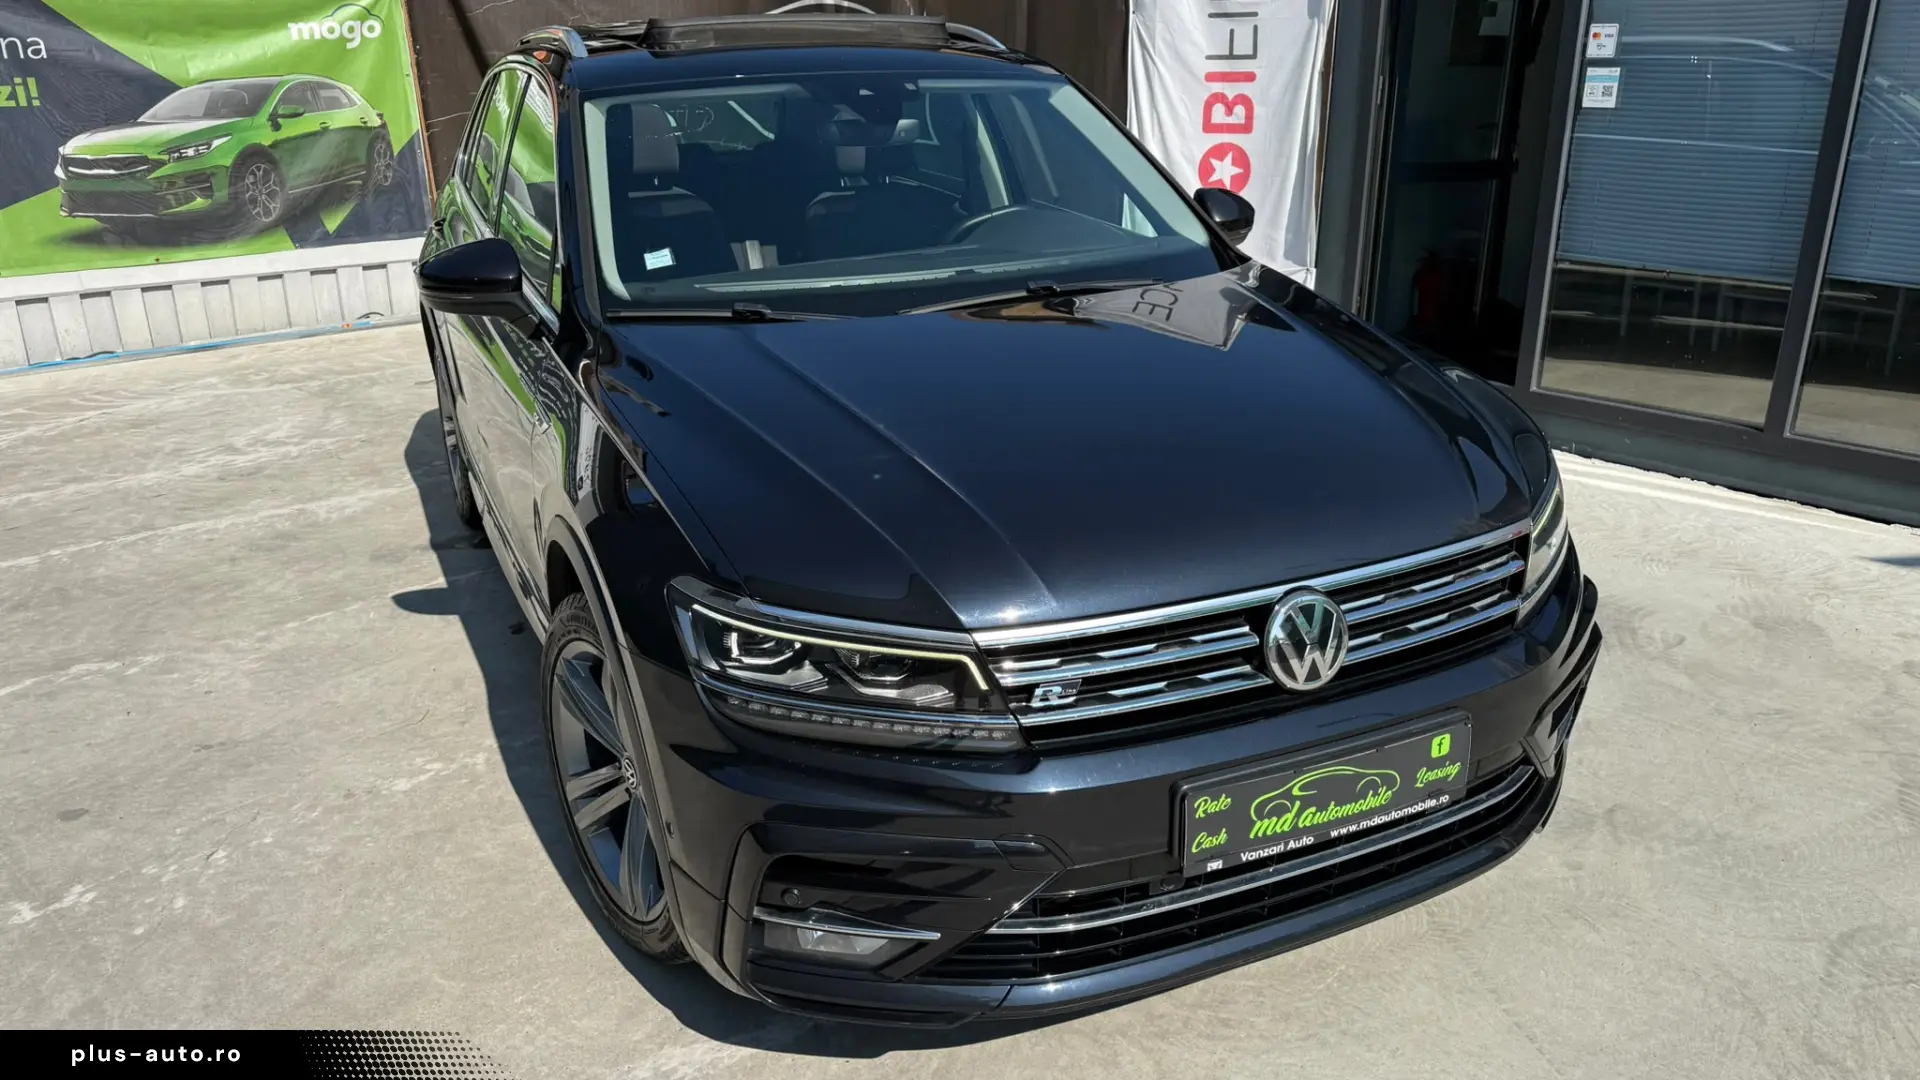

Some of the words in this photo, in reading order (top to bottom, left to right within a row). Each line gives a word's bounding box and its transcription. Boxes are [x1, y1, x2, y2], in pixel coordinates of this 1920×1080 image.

[287, 19, 381, 49] mogo
[0, 36, 48, 60] na
[0, 76, 41, 108] zi!
[1413, 761, 1462, 788] Leasing
[1194, 793, 1232, 819] Rate
[1249, 800, 1301, 839] md
[1329, 794, 1450, 839] www.mdautomobile.ro
[1191, 827, 1229, 853] Cash
[1240, 845, 1285, 862] Vanzari
[1287, 835, 1315, 850] Auto
